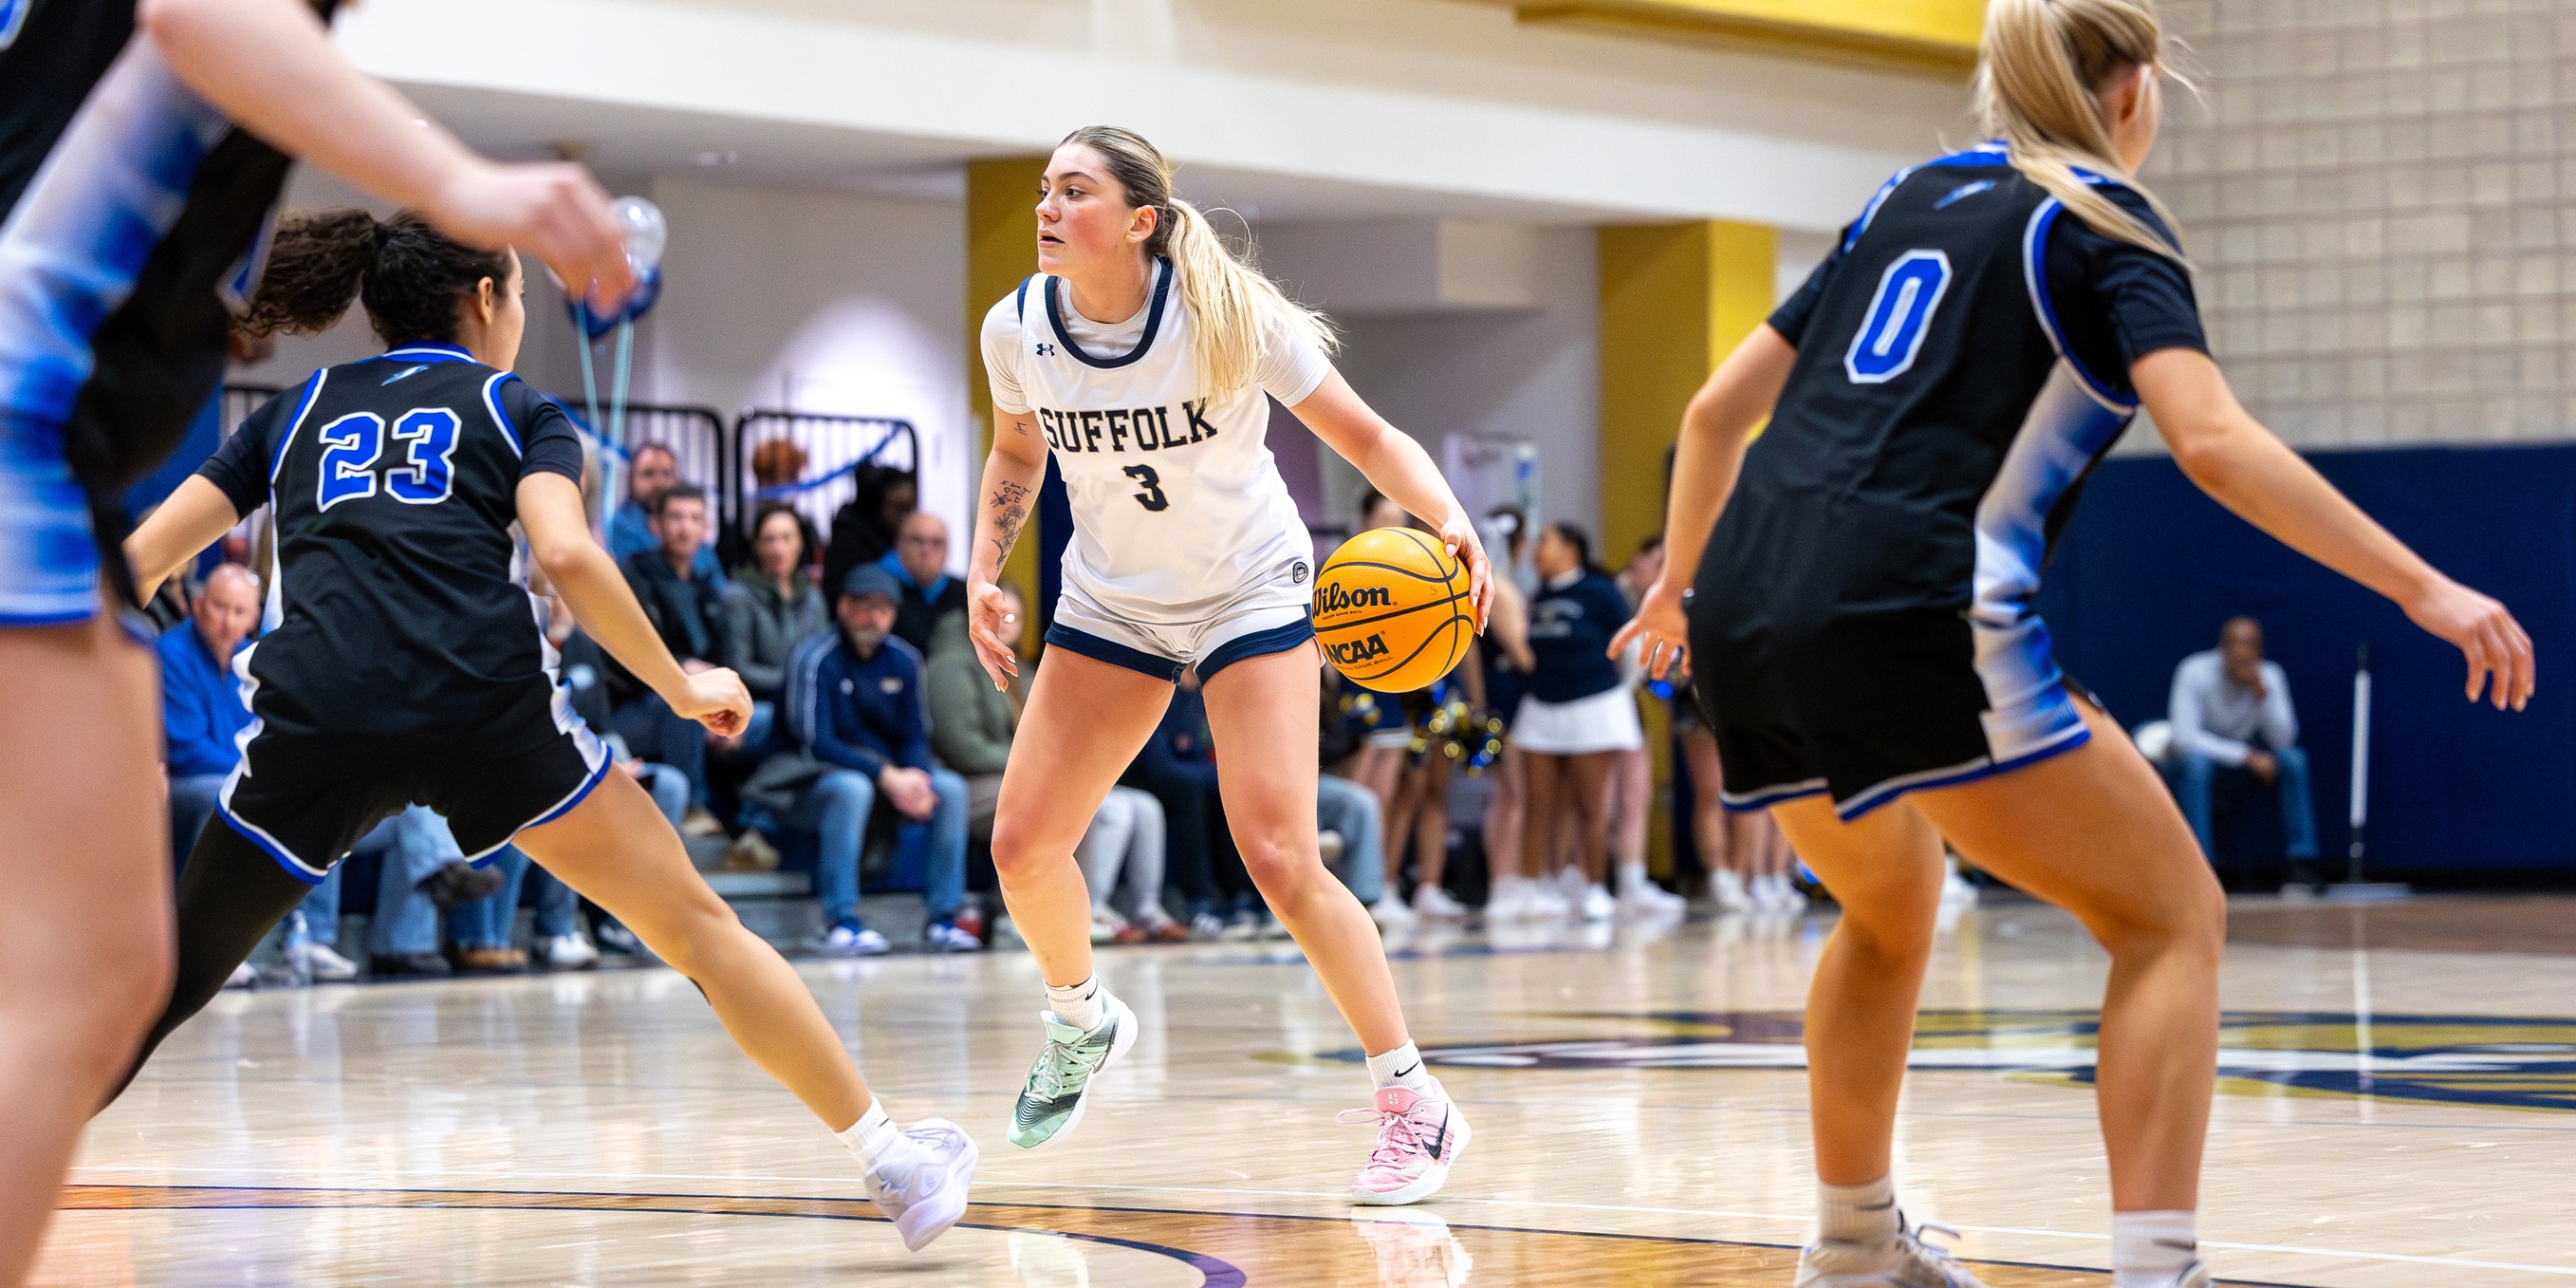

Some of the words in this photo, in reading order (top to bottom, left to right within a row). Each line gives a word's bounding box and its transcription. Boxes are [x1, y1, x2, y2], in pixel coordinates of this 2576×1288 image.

[1844, 249, 1953, 383] 0
[1040, 397, 1217, 453] SUFFOLK
[316, 407, 462, 513] 23
[1122, 463, 1170, 512] 3
[1312, 582, 1392, 620] Wilson
[1324, 633, 1389, 664] NCAA
